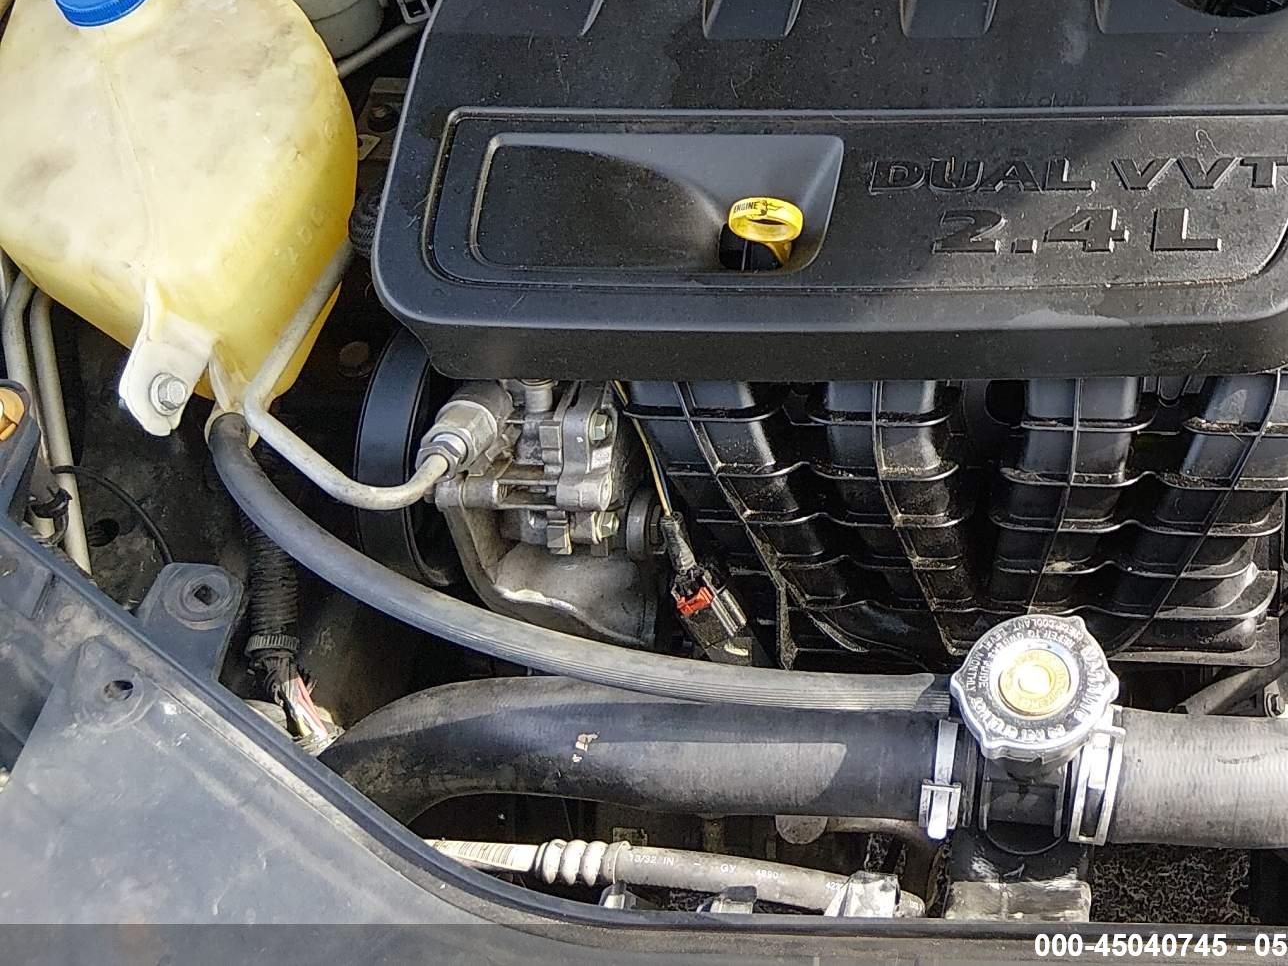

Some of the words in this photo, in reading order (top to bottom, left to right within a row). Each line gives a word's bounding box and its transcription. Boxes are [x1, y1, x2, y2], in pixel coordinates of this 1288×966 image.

[869, 155, 1096, 194] DUAL
[733, 201, 760, 214] ENGINE
[1012, 617, 1055, 631] COOLANT
[978, 628, 1006, 650] LEVEL
[1026, 629, 1041, 640] TO
[966, 650, 982, 691] MONTHLY
